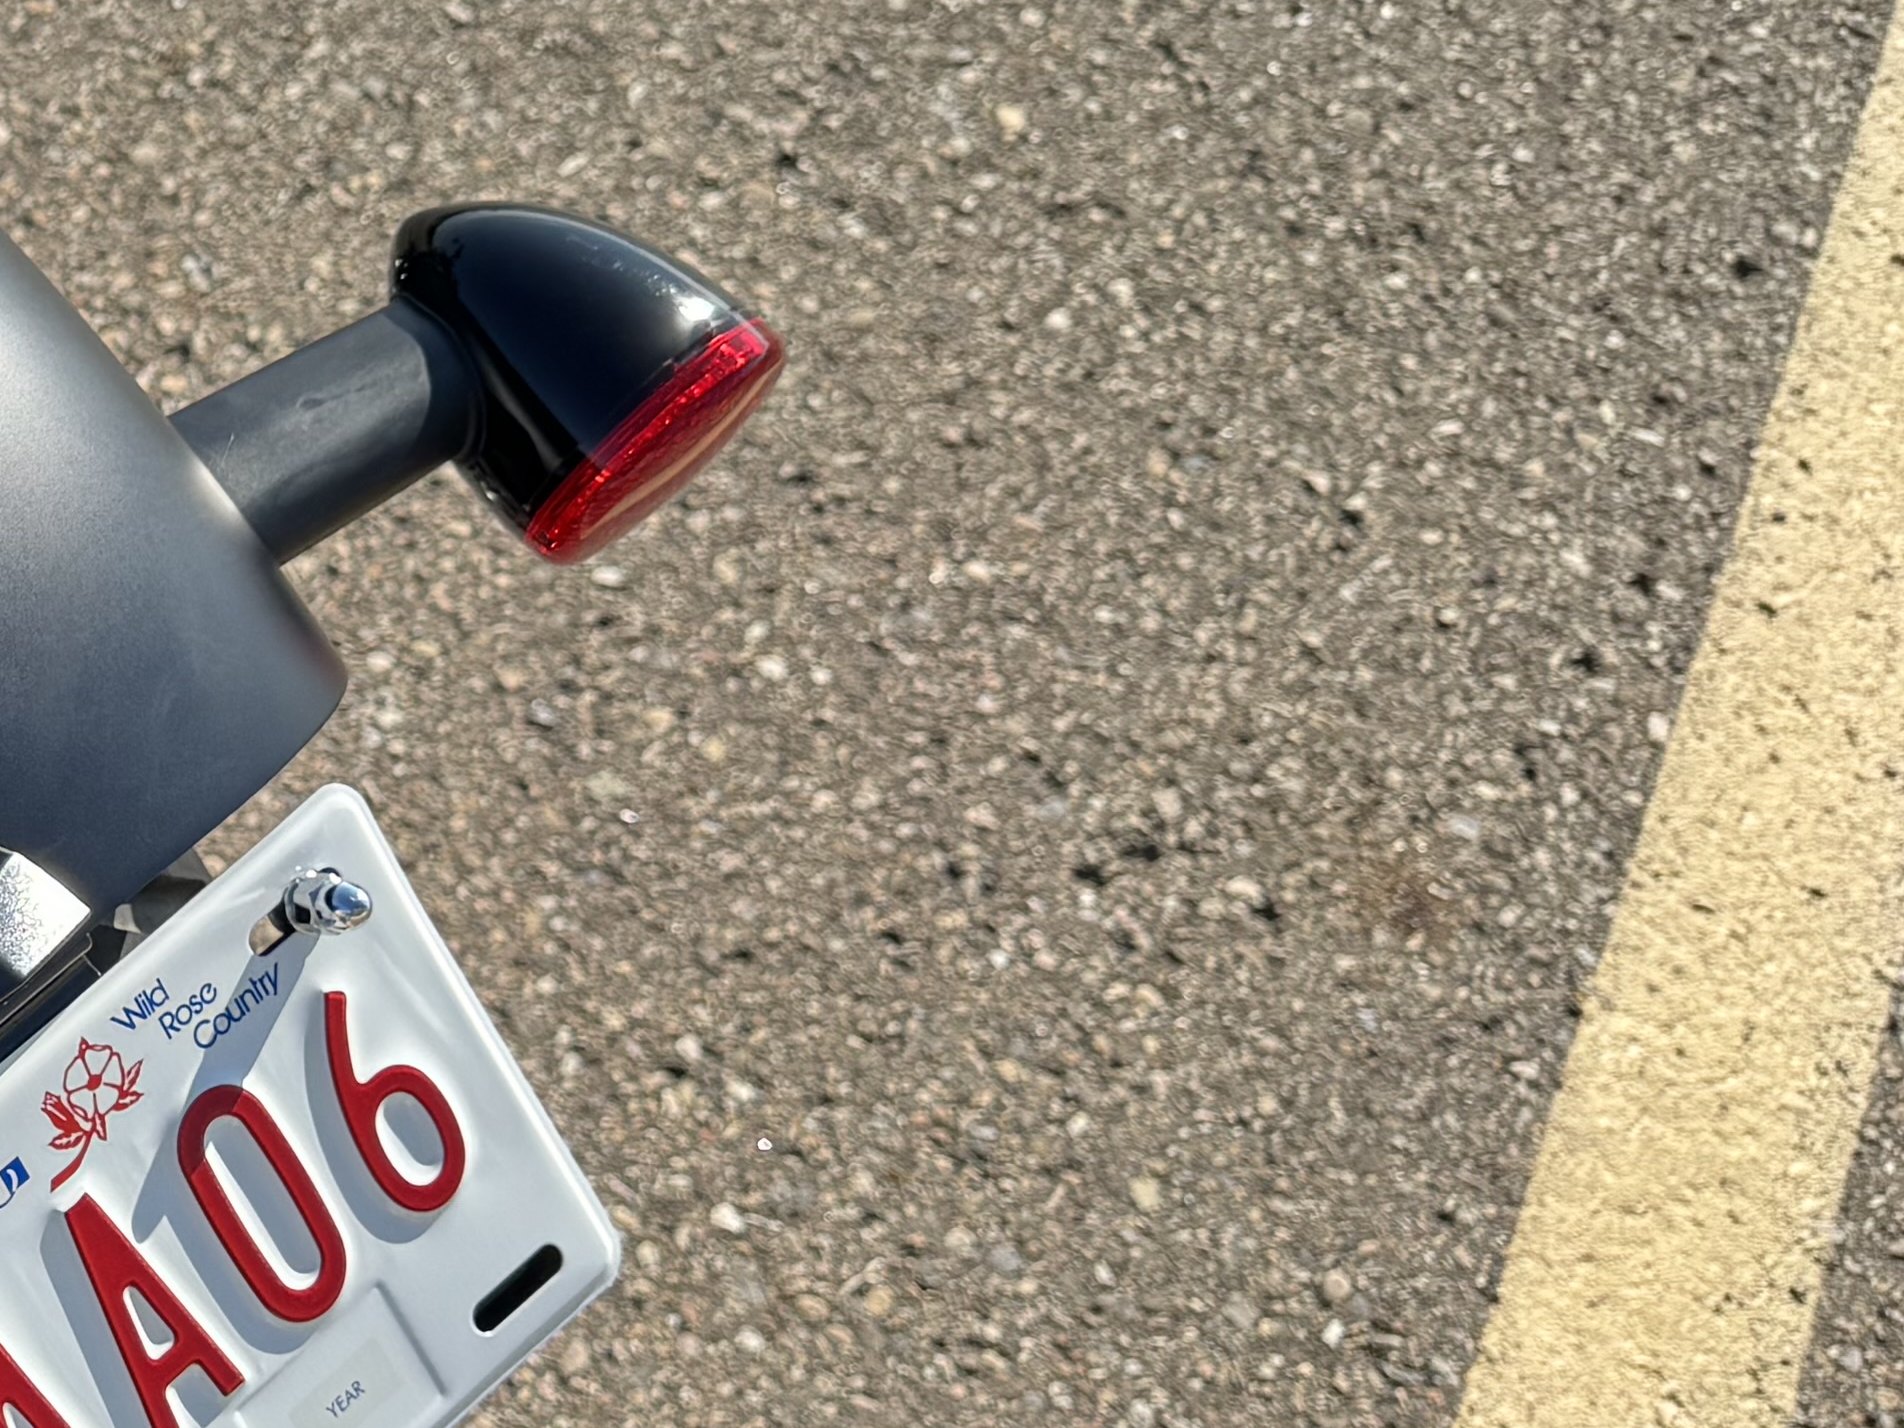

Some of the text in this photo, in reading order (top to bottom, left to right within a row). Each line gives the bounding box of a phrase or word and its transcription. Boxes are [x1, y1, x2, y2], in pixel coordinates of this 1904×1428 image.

[110, 978, 171, 1031] Wild
[158, 982, 217, 1040] Rose
[193, 963, 279, 1049] Country
[325, 1380, 366, 1419] YEAR
